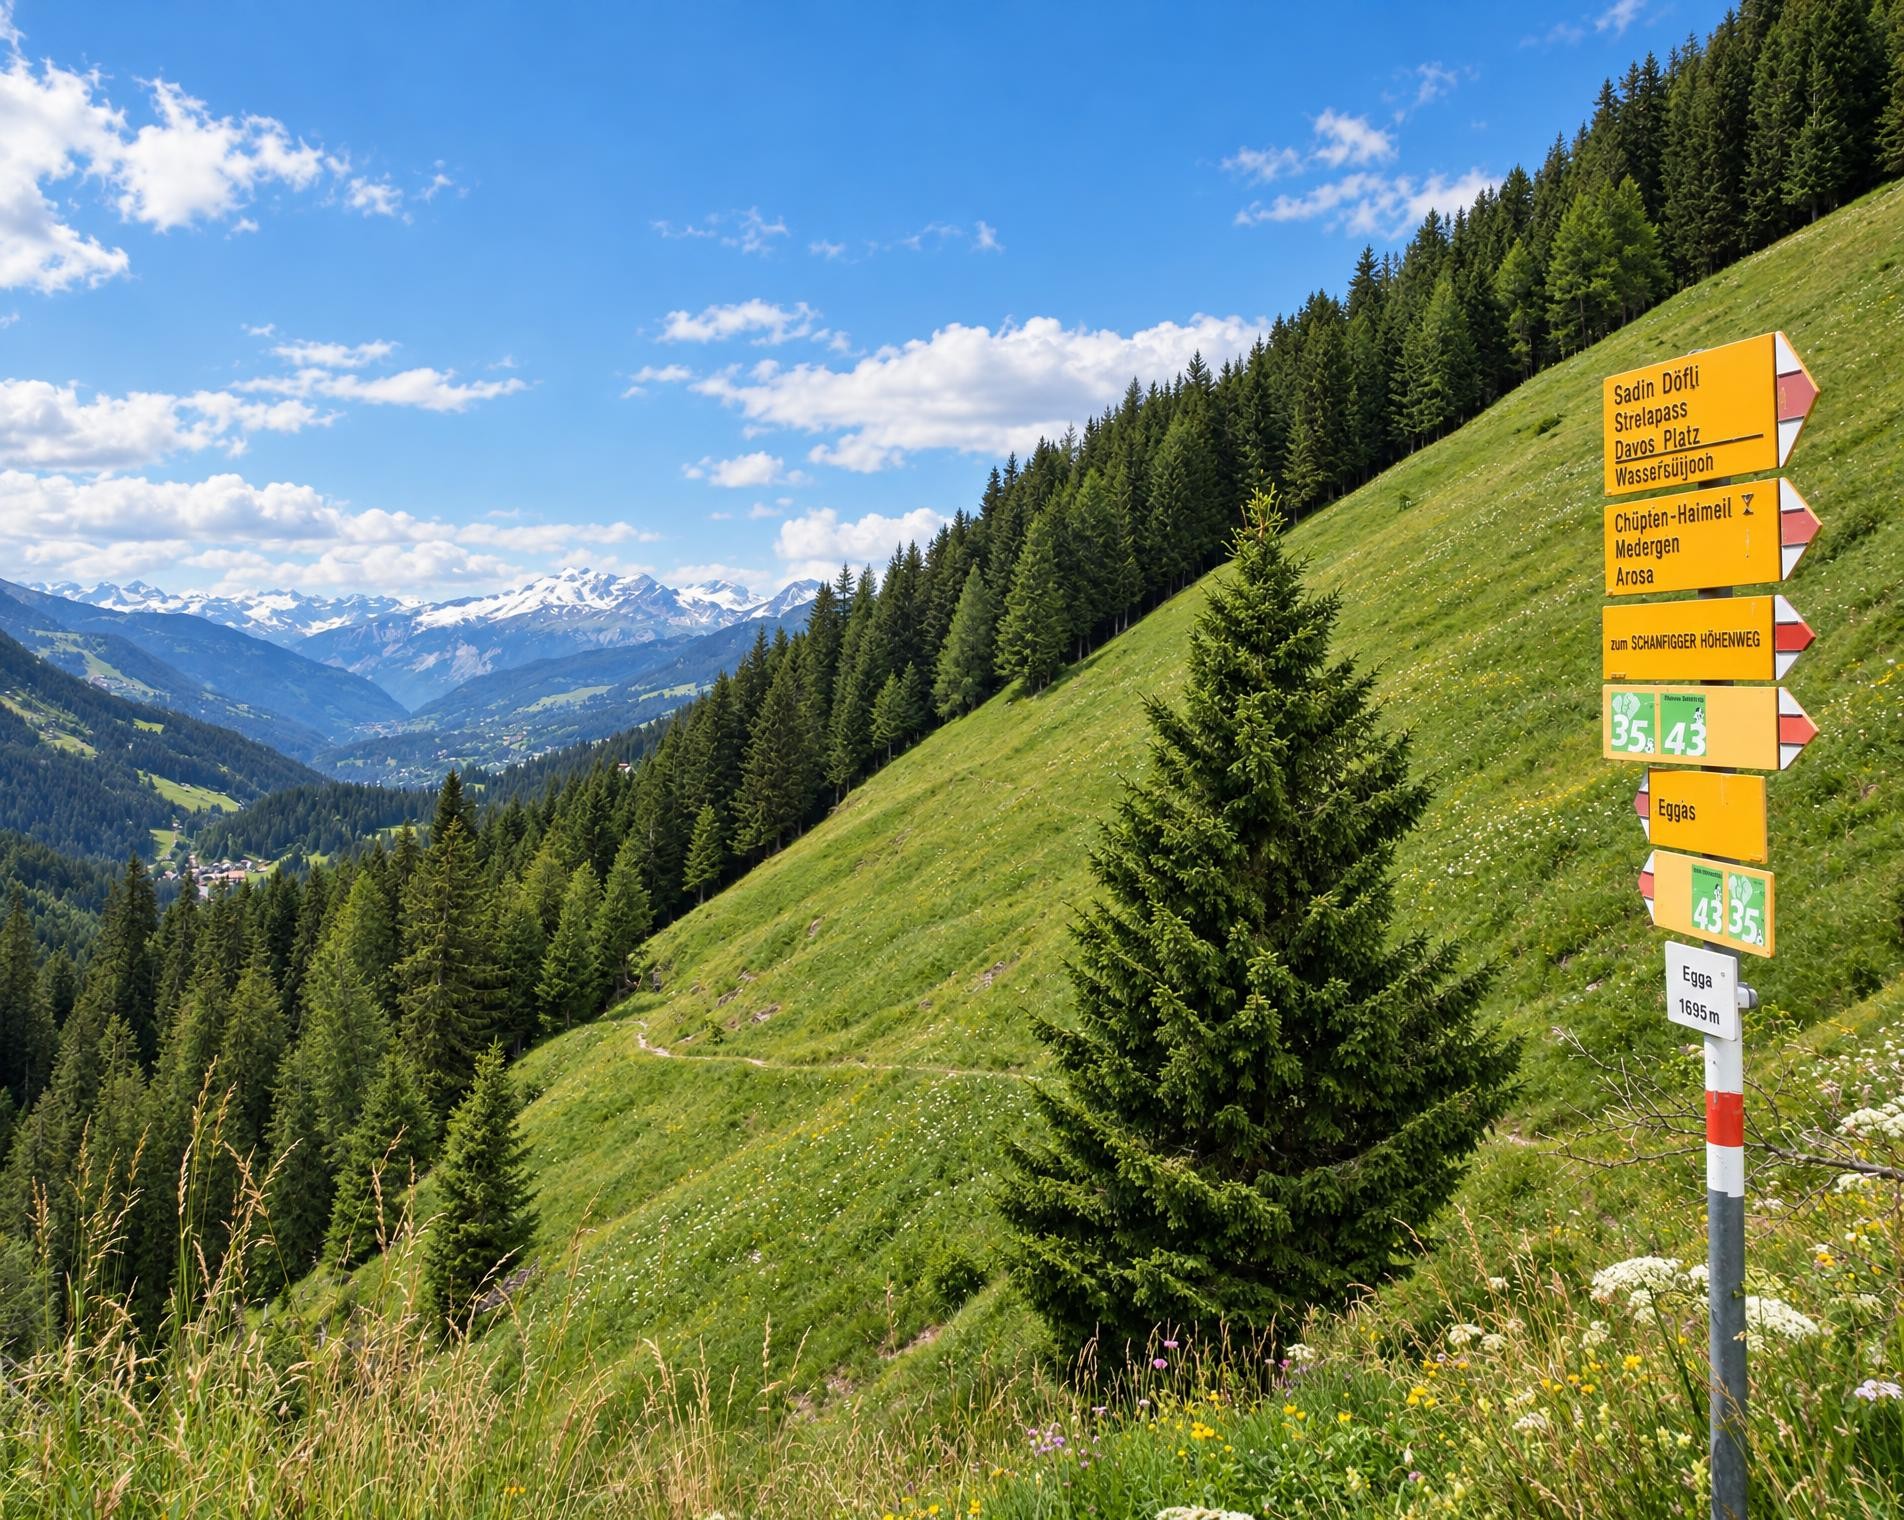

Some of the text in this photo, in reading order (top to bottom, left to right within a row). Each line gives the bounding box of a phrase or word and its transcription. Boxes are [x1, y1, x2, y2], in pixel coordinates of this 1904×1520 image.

[1614, 379, 1655, 406] Sadin
[1615, 401, 1688, 433] Strelapass
[1615, 426, 1700, 460] Davos Platz
[1616, 536, 1680, 559] Medergen
[1616, 567, 1654, 586] Arosa
[1611, 630, 1760, 651] zum SCHANFIGGER HÖHENWEG
[1664, 721, 1707, 756] 43
[1659, 798, 1696, 822] Eggas
[1693, 896, 1723, 934] 43
[1683, 965, 1713, 990] Egga
